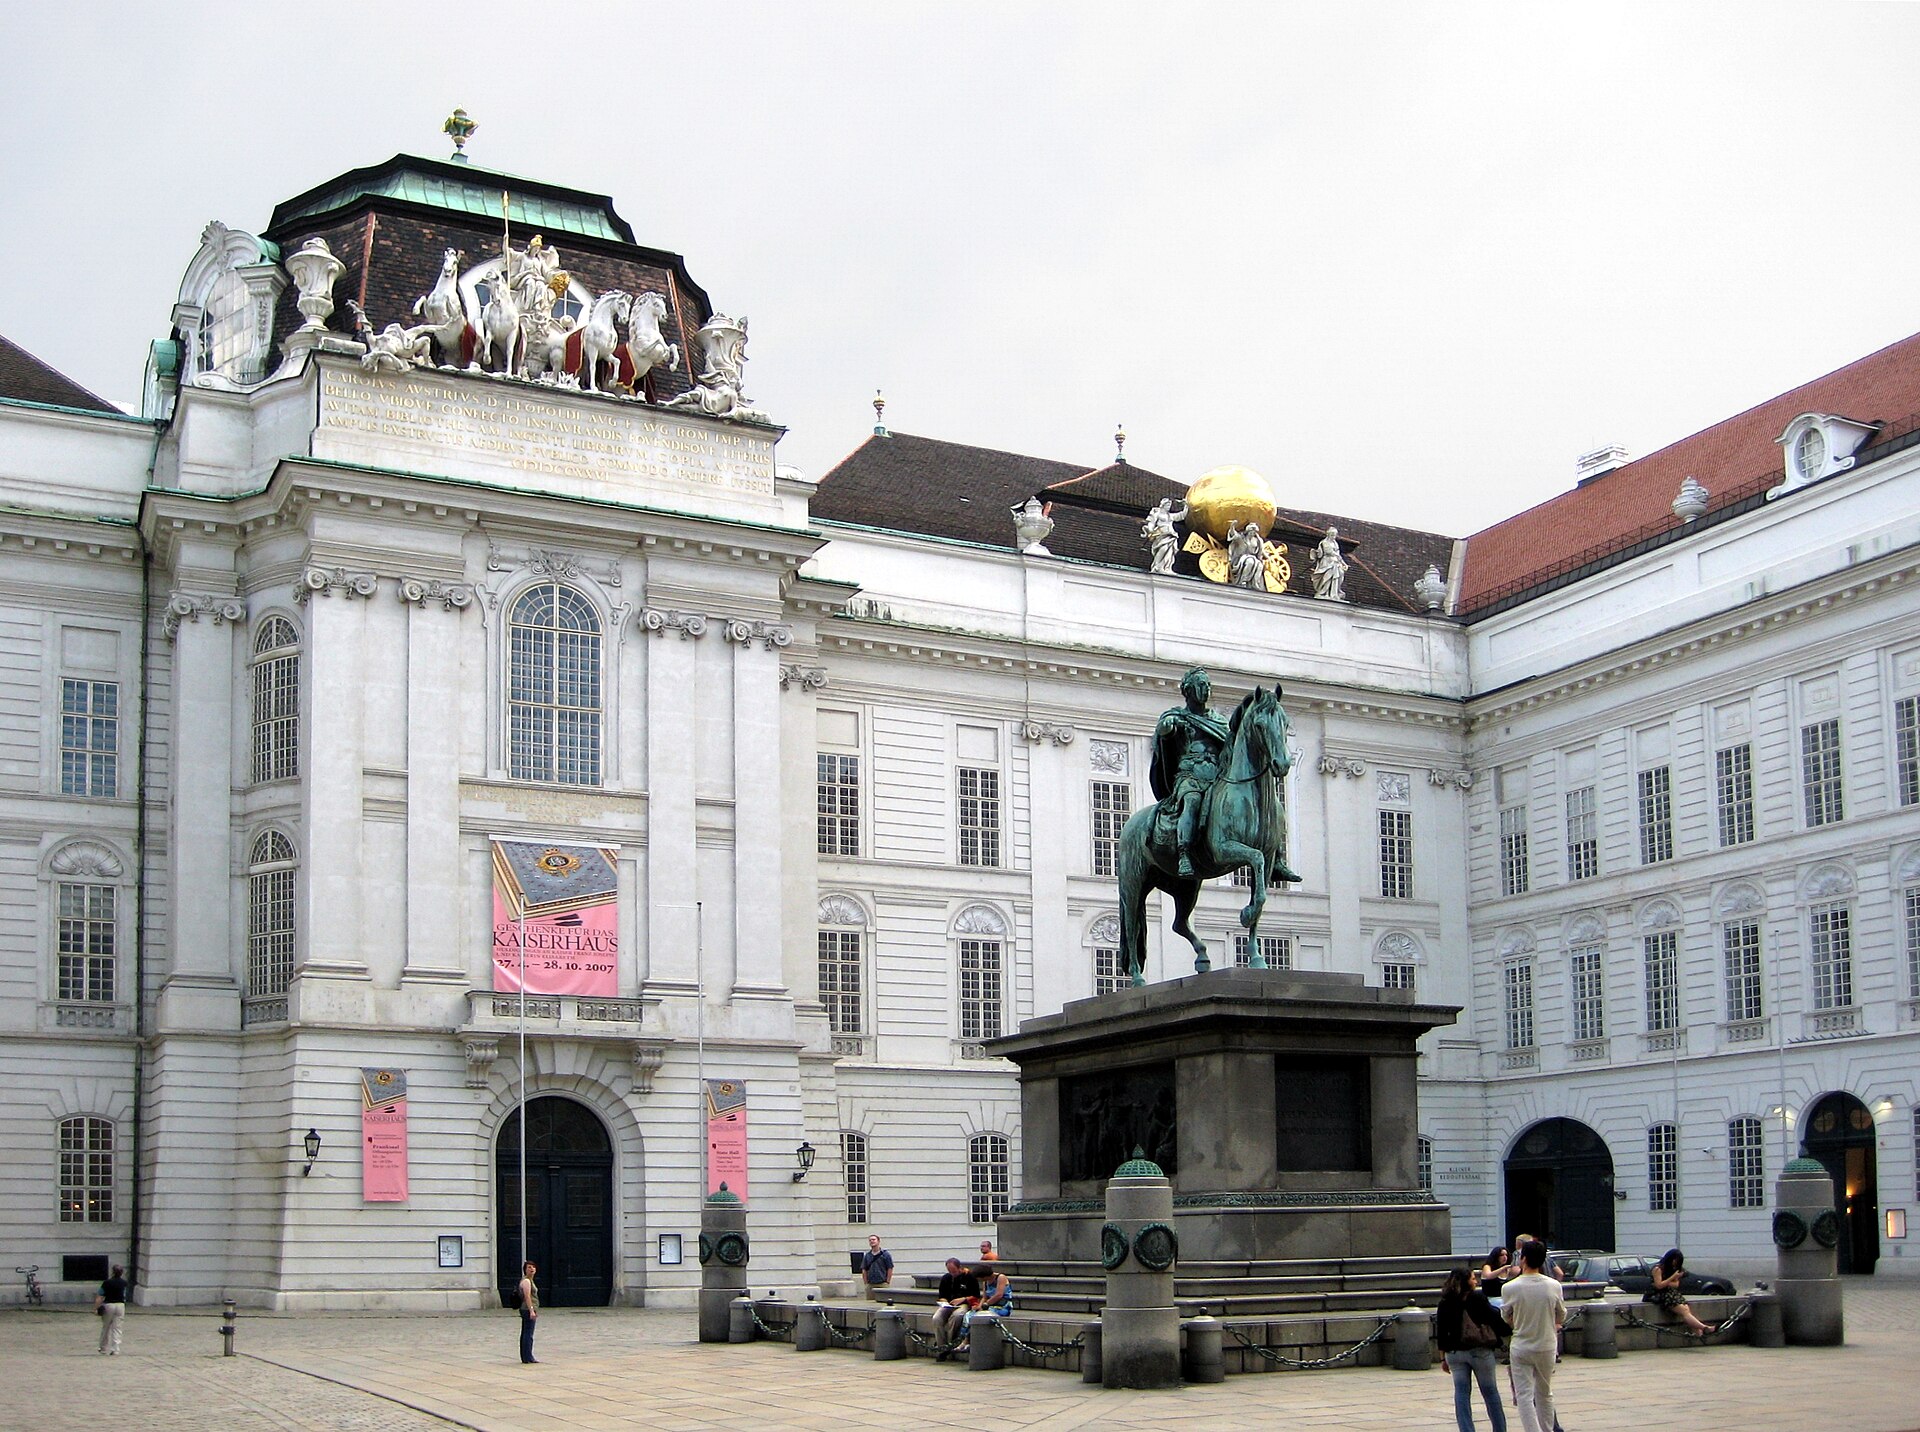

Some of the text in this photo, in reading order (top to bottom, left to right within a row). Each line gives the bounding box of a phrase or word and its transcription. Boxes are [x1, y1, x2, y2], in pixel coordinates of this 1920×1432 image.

[325, 384, 371, 401] BELLO
[526, 416, 622, 441] INSTAVRANDIS
[326, 370, 396, 391] CAROLVS
[405, 384, 480, 404] AVSTRIVS
[589, 414, 617, 427] AVG
[642, 421, 669, 435] AVG
[676, 427, 708, 441] ROM
[715, 432, 741, 446] IMP
[386, 409, 501, 436] BIBLIOTHECAM
[493, 931, 618, 953] KAISERHAUS
[568, 926, 590, 937] FÜR
[592, 928, 615, 938] DAS
[543, 960, 562, 970] 28.
[566, 962, 582, 971] 10.
[585, 963, 615, 974] 2007
